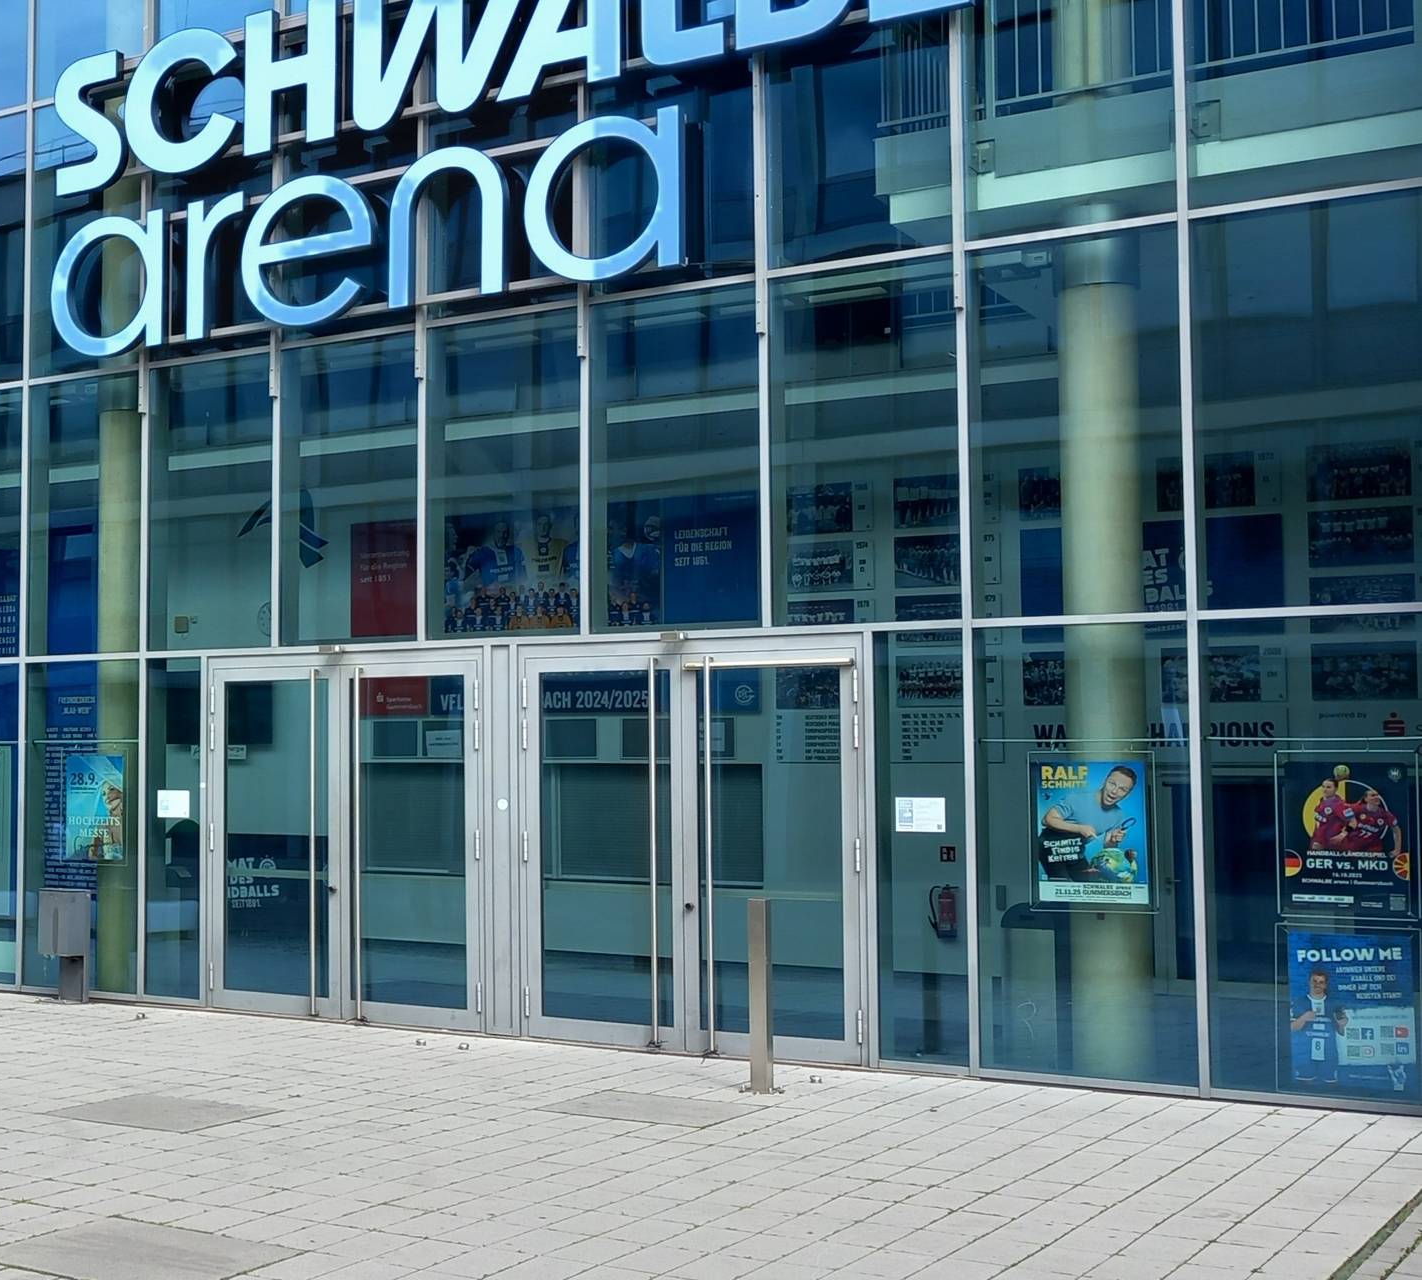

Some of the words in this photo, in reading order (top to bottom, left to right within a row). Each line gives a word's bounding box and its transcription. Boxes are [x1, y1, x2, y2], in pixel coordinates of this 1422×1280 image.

[51, 105, 679, 357] arena
[690, 541, 704, 552] DIE
[704, 539, 733, 552] REGION
[674, 556, 690, 567] SEIT
[542, 691, 572, 709] ACH
[576, 688, 649, 708] 2024/2025
[70, 772, 99, 786] 28.9.
[1041, 765, 1088, 780] RALF
[68, 816, 121, 826] HOCHZEITS
[1306, 858, 1333, 870] GER
[1336, 861, 1355, 870] vs.
[1357, 859, 1389, 871] MKD
[1296, 948, 1375, 963] FOLLOW
[1378, 947, 1403, 961] ME
